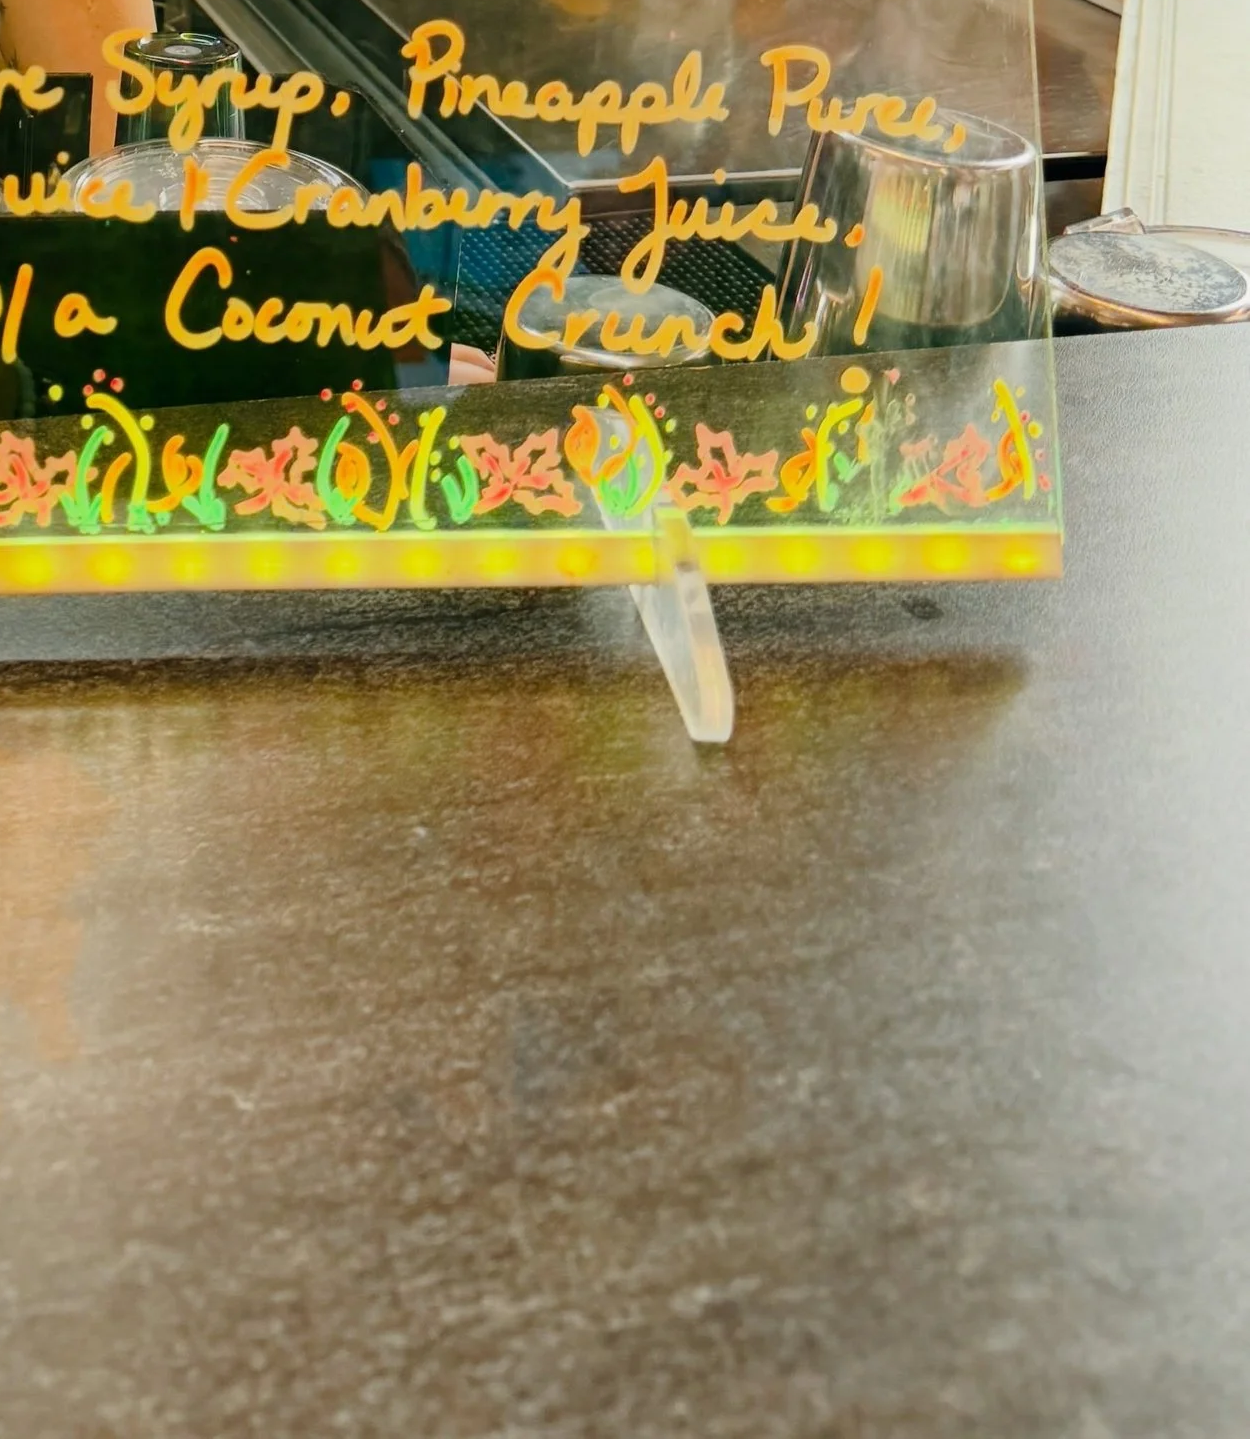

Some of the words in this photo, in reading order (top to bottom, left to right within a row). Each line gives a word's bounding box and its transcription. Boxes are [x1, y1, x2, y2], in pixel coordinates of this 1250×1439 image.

[402, 19, 729, 157] Pineapple
[226, 149, 589, 283] Cranberry
[54, 293, 118, 337] a
[165, 247, 452, 350] Coconut
